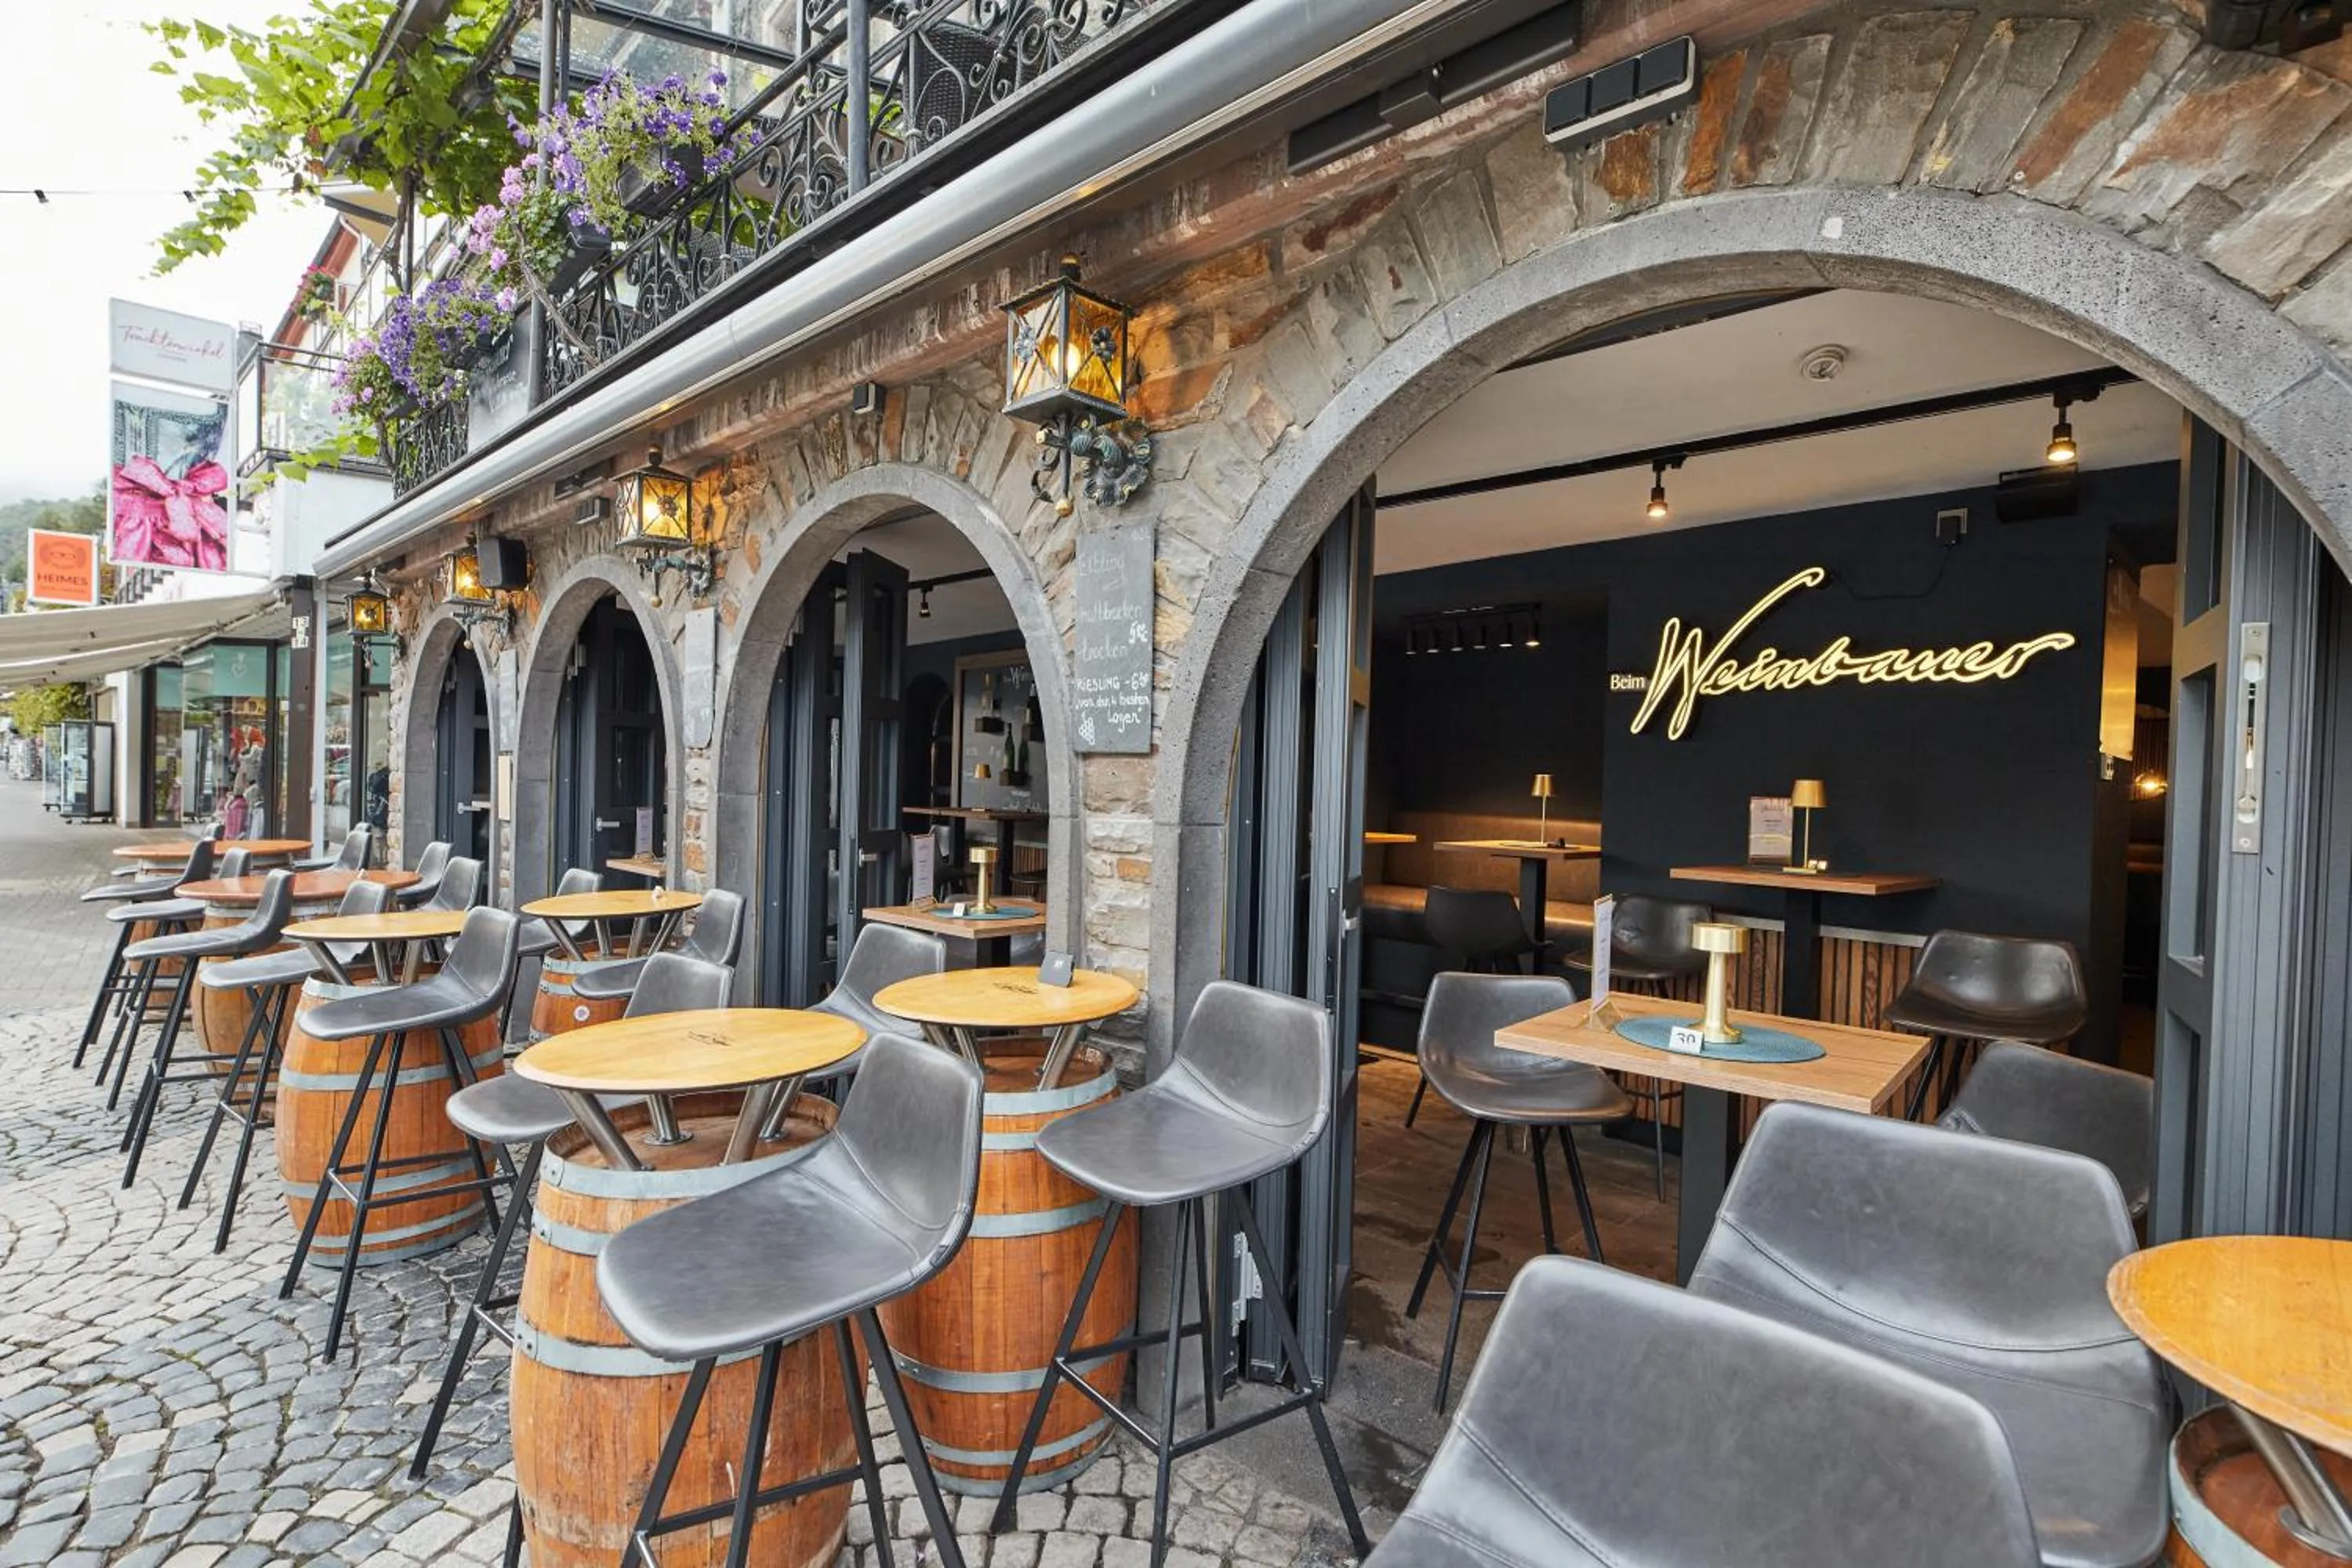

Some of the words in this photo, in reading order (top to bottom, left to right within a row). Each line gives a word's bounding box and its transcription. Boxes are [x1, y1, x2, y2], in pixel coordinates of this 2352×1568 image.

[36, 573, 89, 586] HEIMES
[1610, 673, 1646, 690] Beim
[1631, 568, 2075, 739] Weinbauer
